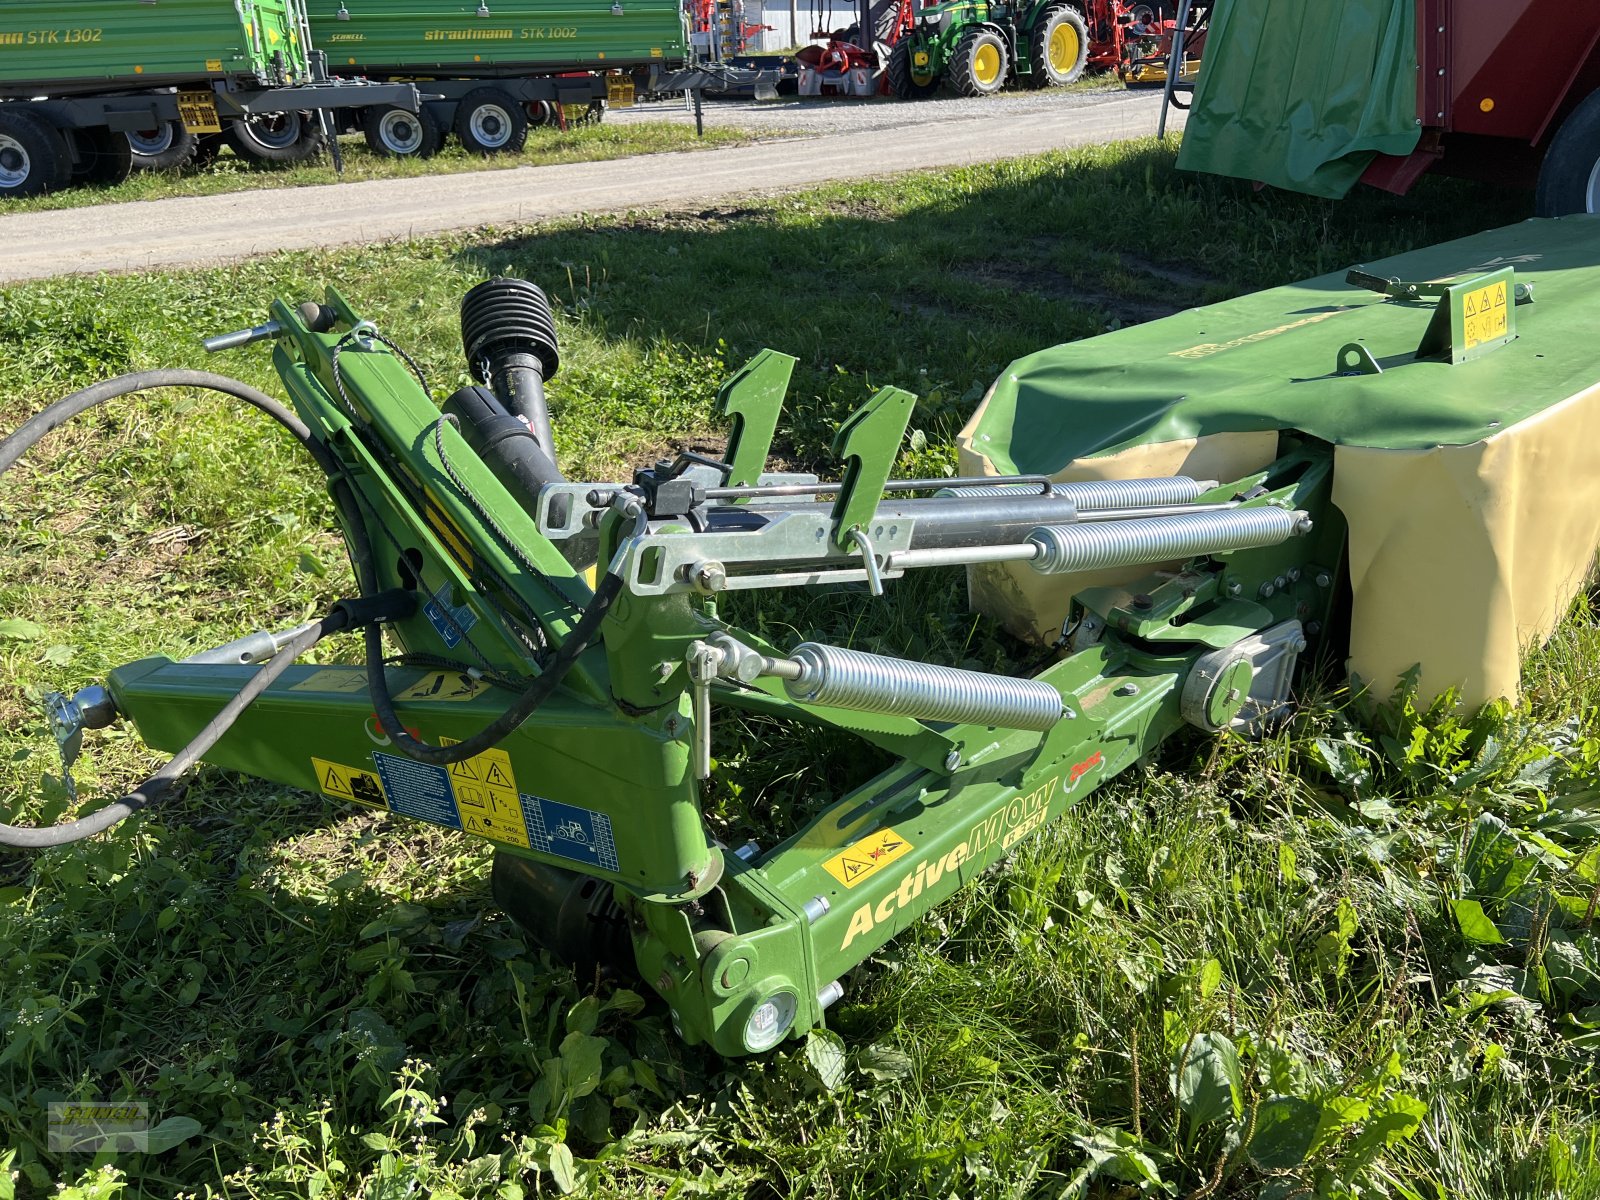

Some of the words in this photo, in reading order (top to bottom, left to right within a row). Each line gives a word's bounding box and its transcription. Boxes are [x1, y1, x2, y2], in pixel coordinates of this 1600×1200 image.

[26, 30, 60, 45] STK
[64, 28, 103, 43] 1302
[424, 29, 513, 40] strautmann
[520, 28, 545, 39] STK
[547, 27, 578, 38] 1002
